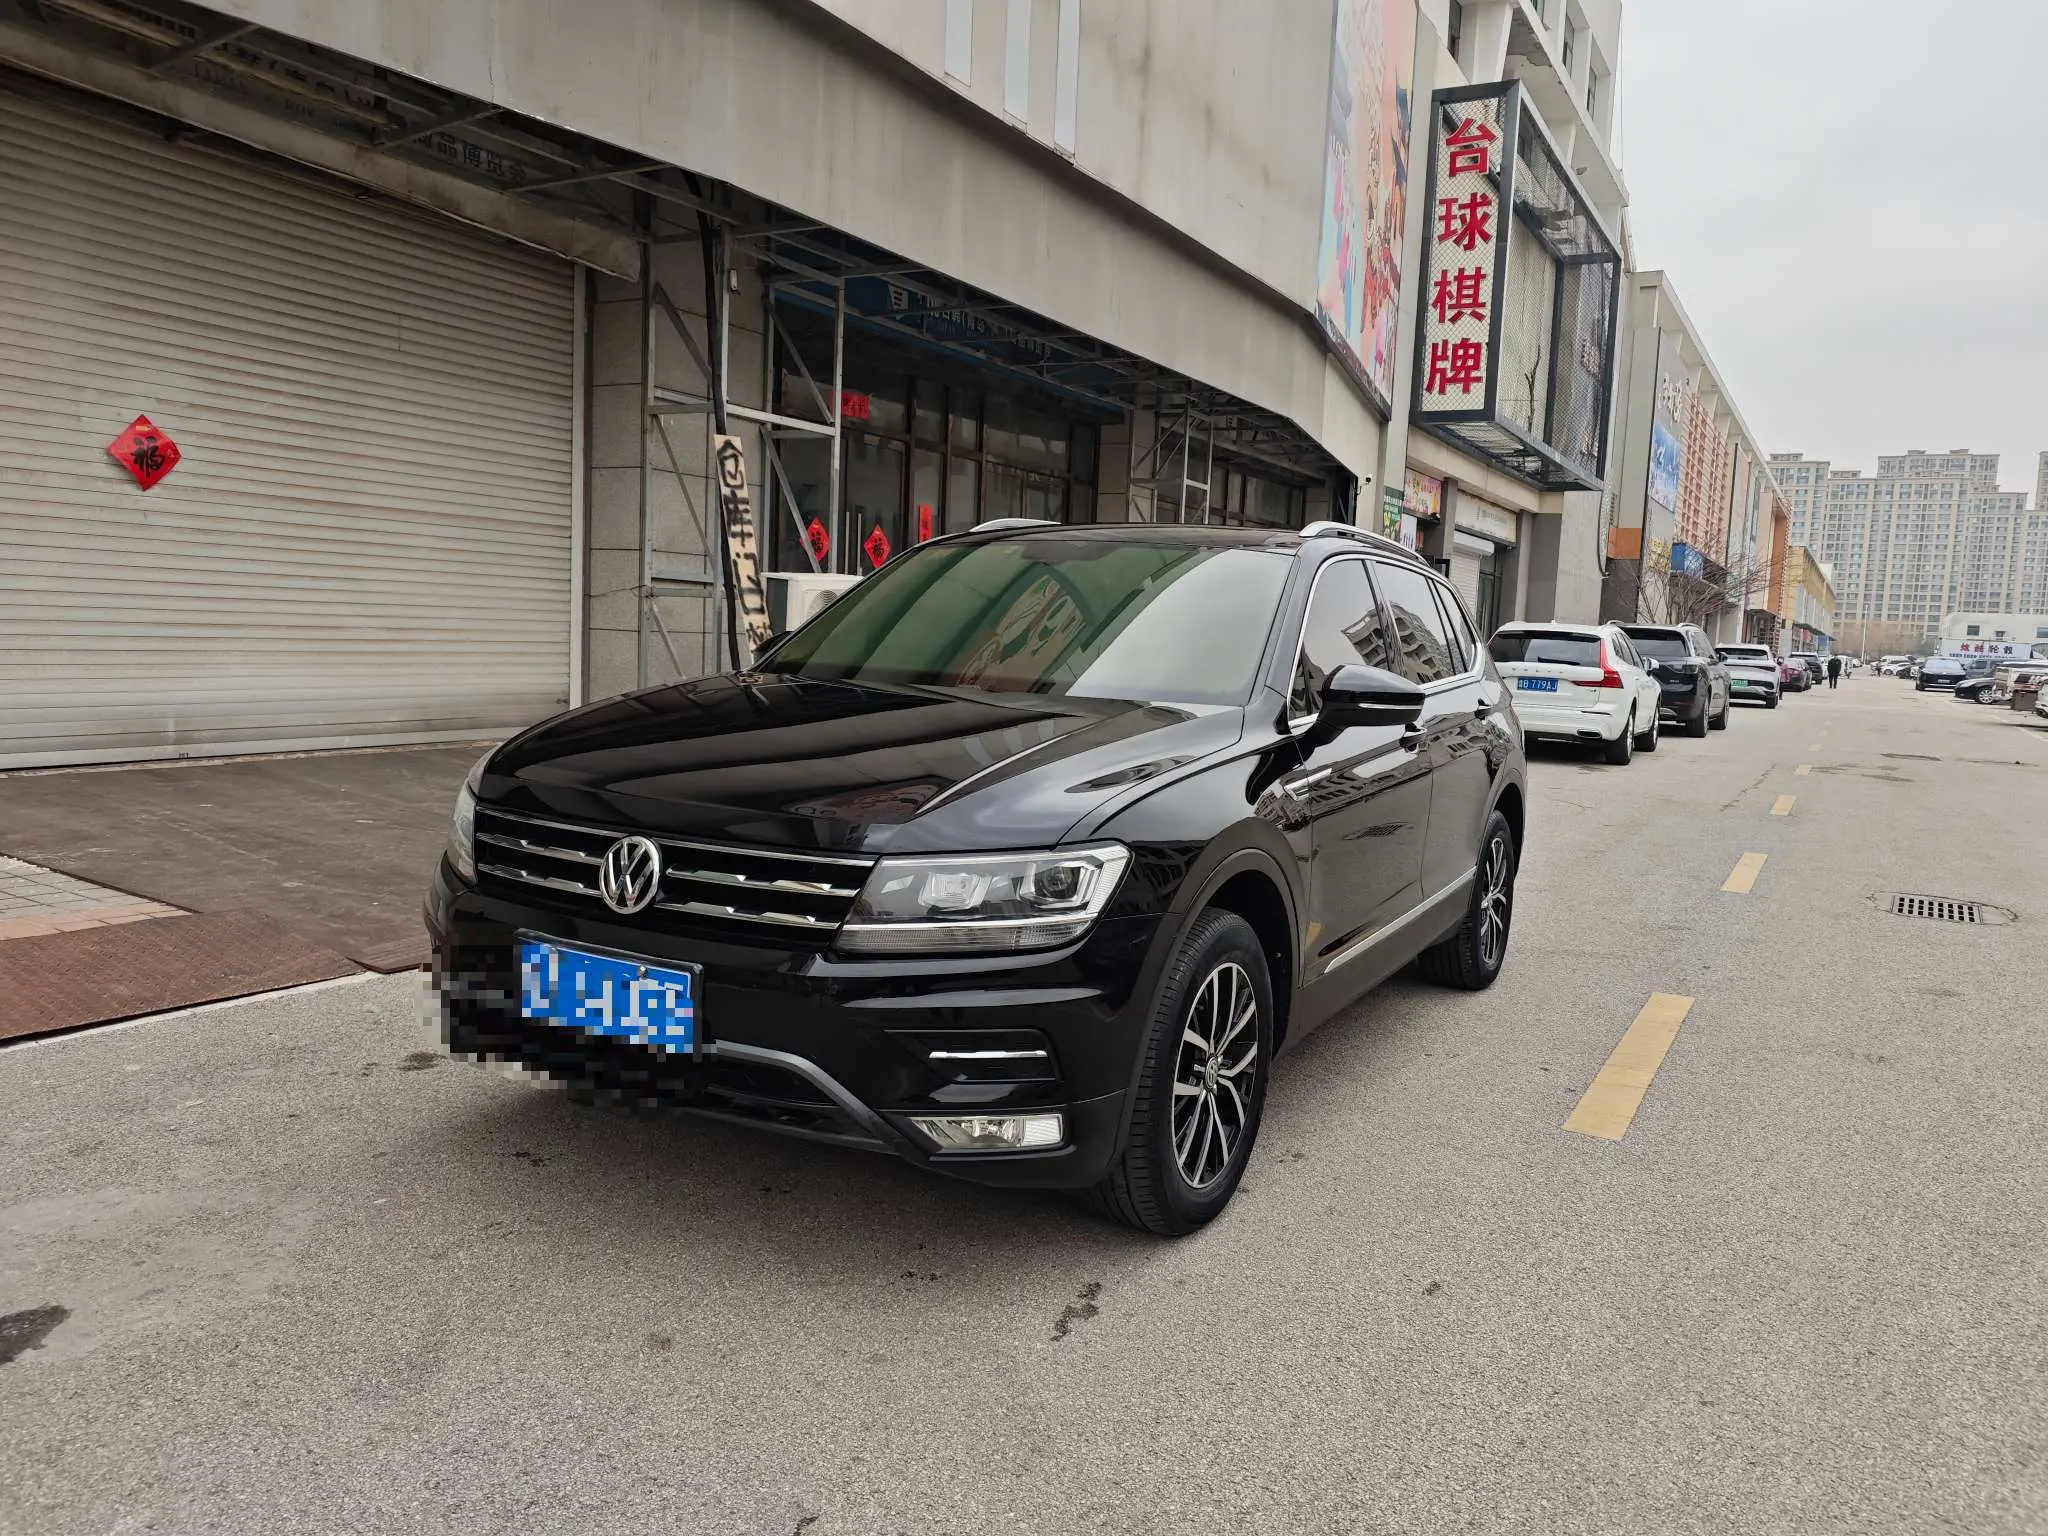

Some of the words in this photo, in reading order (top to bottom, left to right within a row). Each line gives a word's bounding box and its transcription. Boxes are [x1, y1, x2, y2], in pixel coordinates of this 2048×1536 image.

[1425, 117, 1497, 396] 台球棋牌
[130, 435, 166, 478] 福
